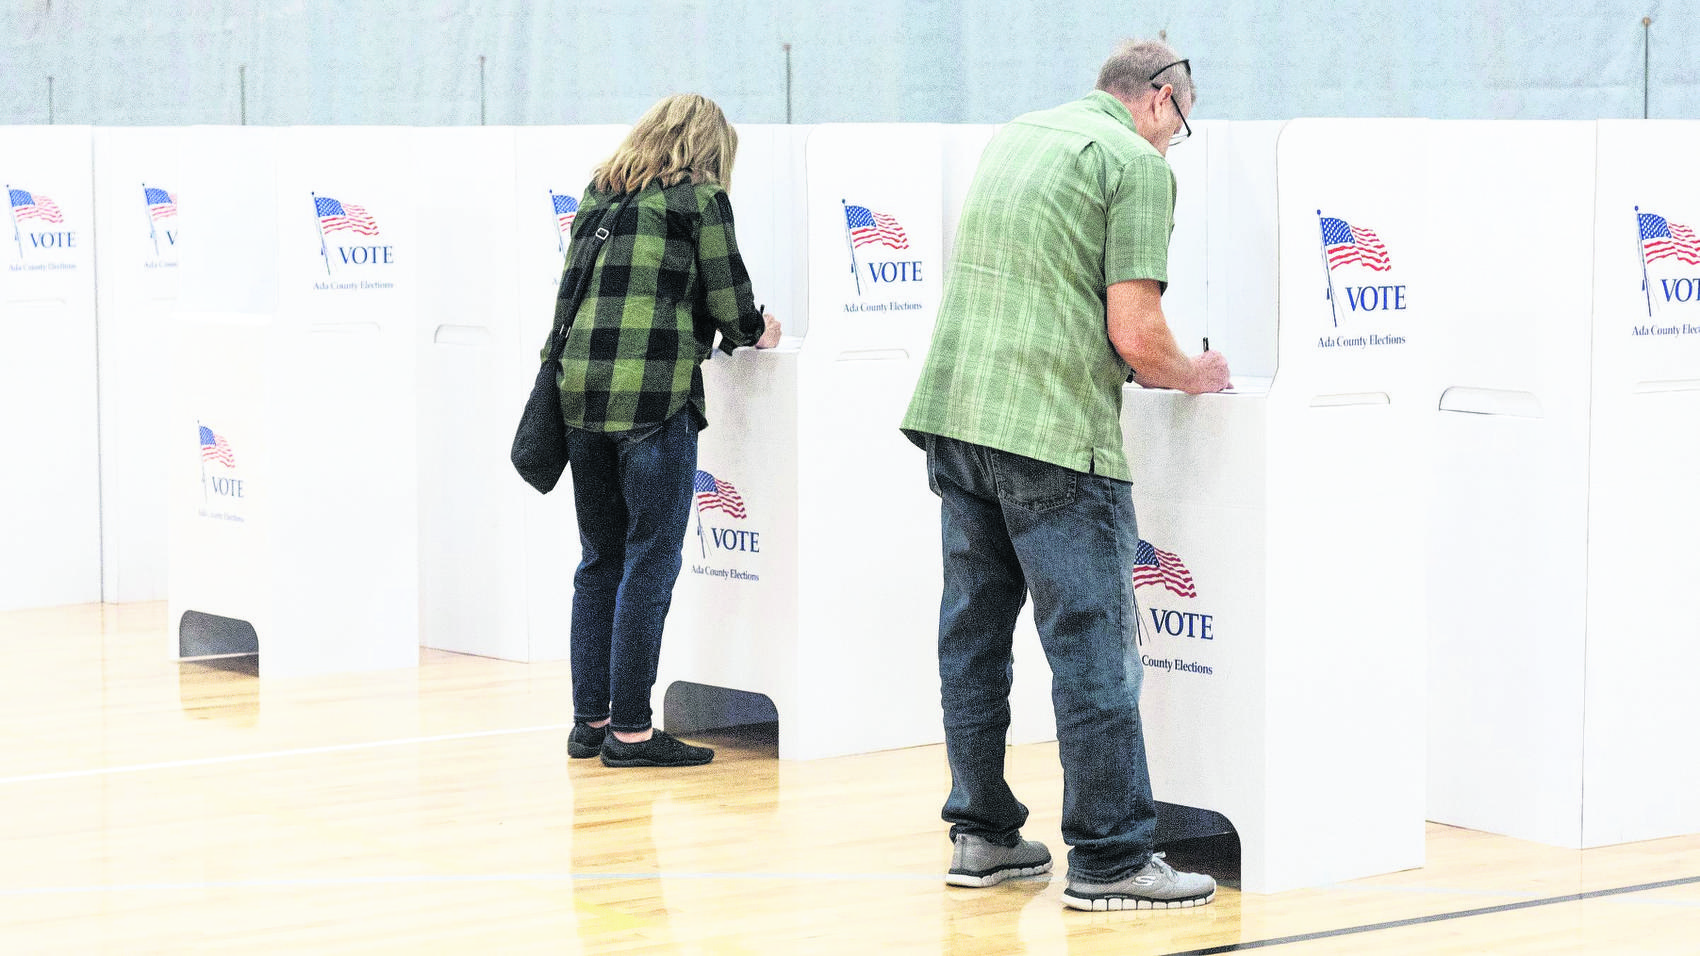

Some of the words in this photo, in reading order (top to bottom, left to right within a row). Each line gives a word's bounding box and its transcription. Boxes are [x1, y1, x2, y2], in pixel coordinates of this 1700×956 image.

[30, 231, 77, 248] VOTE
[338, 245, 394, 264] VOTE
[867, 261, 923, 283] VOTE
[313, 281, 329, 290] Ada
[330, 281, 358, 291] County
[360, 280, 394, 289] Elections
[843, 302, 859, 312] Ada
[860, 302, 887, 314] County
[889, 301, 922, 311] Elections
[1345, 285, 1407, 312] VOTE
[1632, 325, 1649, 336] Ada
[1650, 324, 1680, 338] County
[1318, 336, 1335, 348] Ada
[1336, 335, 1367, 350] County
[1369, 333, 1406, 345] Elections
[212, 476, 245, 498] VOTE
[711, 527, 760, 552] VOTE
[691, 564, 704, 575] Ada
[704, 565, 729, 580] County
[730, 568, 760, 581] Elections
[1149, 607, 1214, 640] VOTE
[1141, 654, 1173, 673] County
[1174, 658, 1213, 675] Elections
